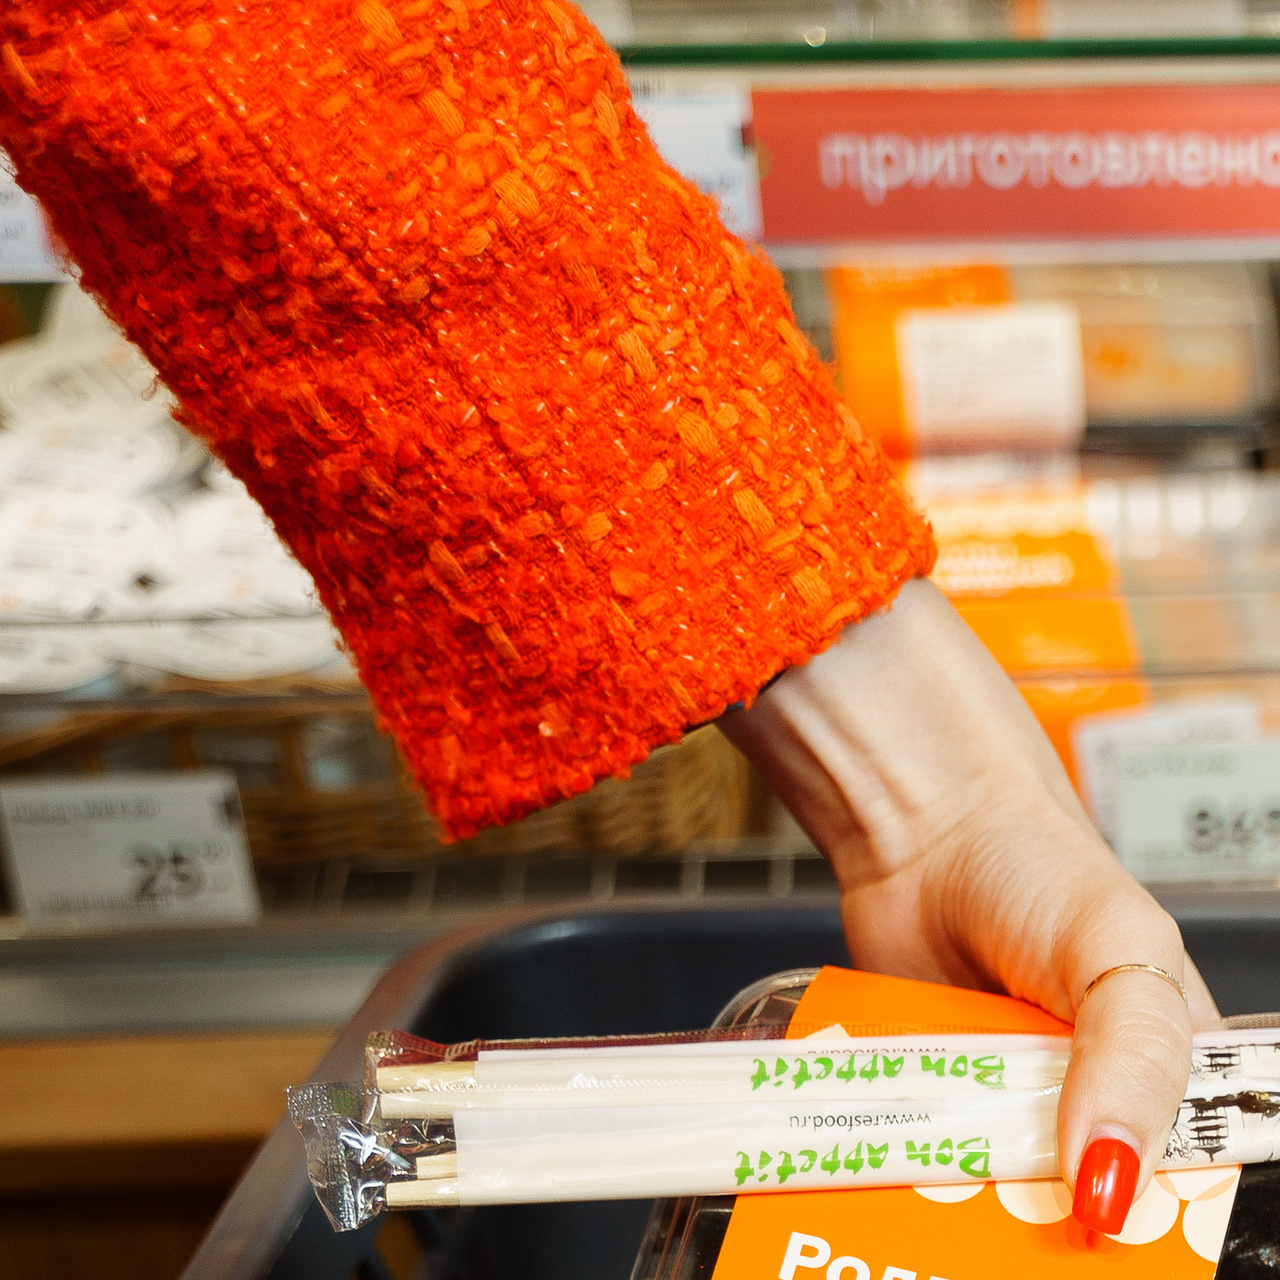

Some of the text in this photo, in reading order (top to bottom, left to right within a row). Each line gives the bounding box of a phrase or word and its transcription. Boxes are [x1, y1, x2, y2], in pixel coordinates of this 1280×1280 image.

[750, 1053, 1006, 1091] Bon appetit
[789, 1113, 932, 1132] www.resfood.ru
[734, 1136, 993, 1187] Bon appetit
